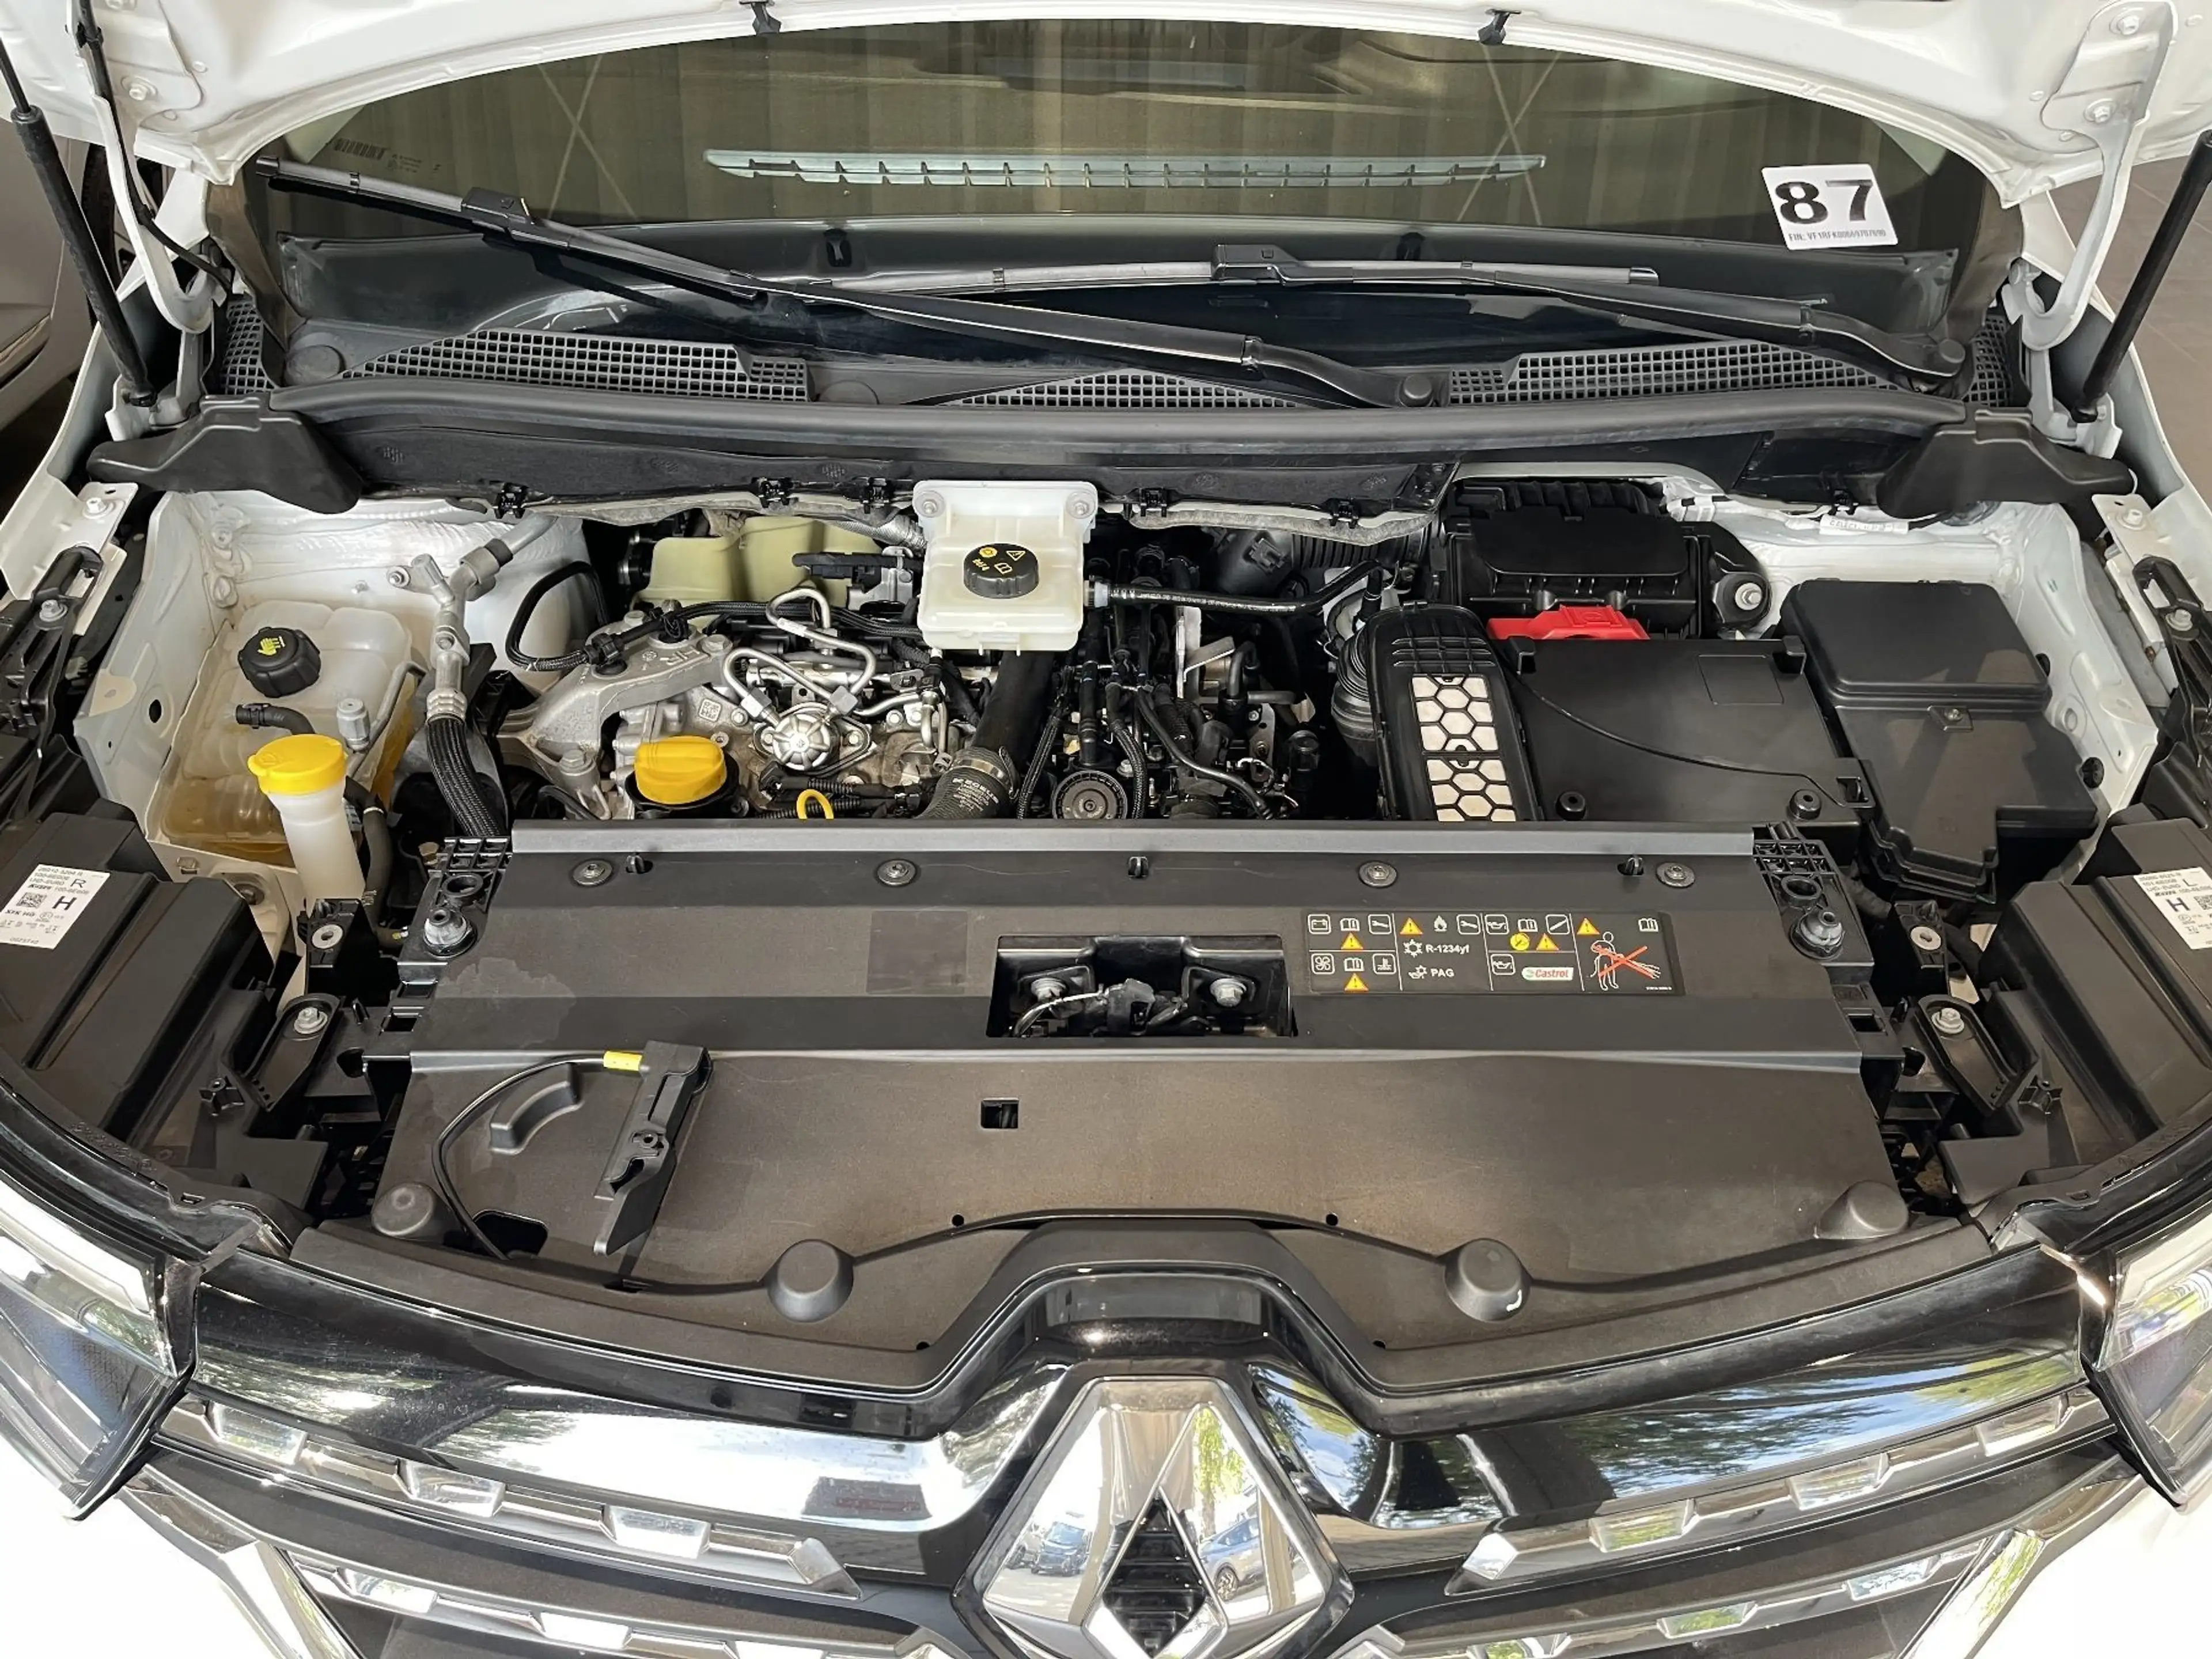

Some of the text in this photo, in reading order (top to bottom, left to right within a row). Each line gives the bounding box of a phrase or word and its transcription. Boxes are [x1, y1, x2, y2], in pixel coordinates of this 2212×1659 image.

[1775, 179, 1874, 225] 87
[70, 878, 87, 888] R
[52, 896, 77, 910] H
[2166, 897, 2191, 912] H
[1425, 944, 1470, 955] R-1234yf
[1430, 968, 1455, 978] PAG
[1535, 969, 1569, 978] Castrol
